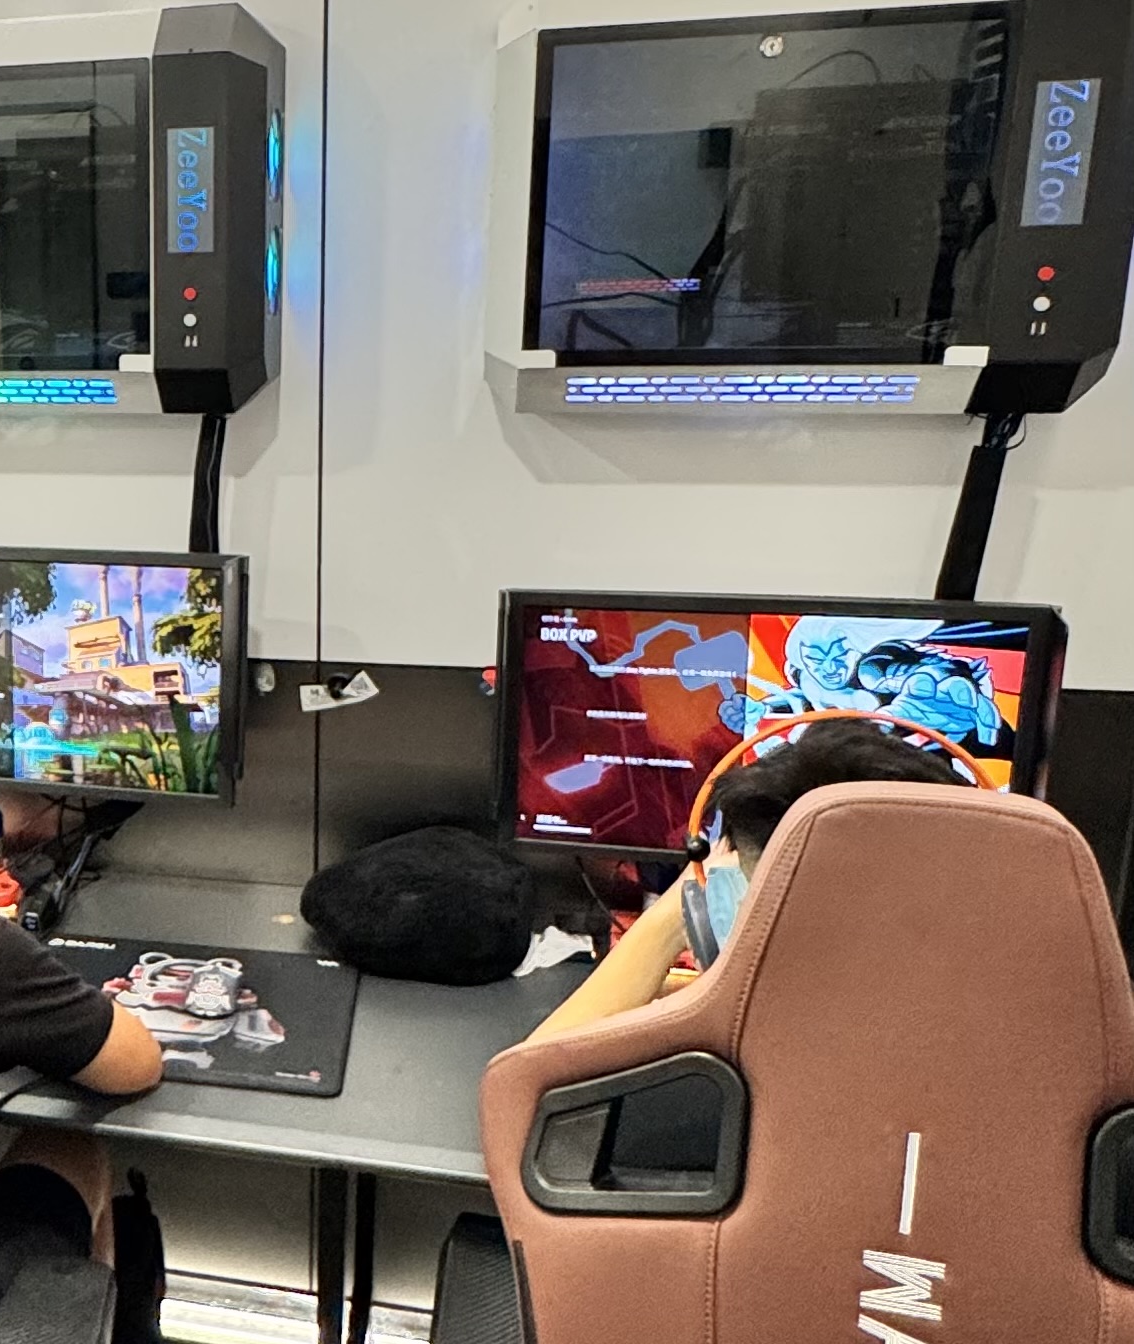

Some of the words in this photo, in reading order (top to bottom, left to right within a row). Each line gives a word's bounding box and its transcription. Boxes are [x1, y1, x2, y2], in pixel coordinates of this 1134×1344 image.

[177, 129, 208, 252] ZeeYoo
[1036, 80, 1090, 224] ZeeYoo
[540, 627, 568, 642] BOX
[569, 628, 598, 643] PVP
